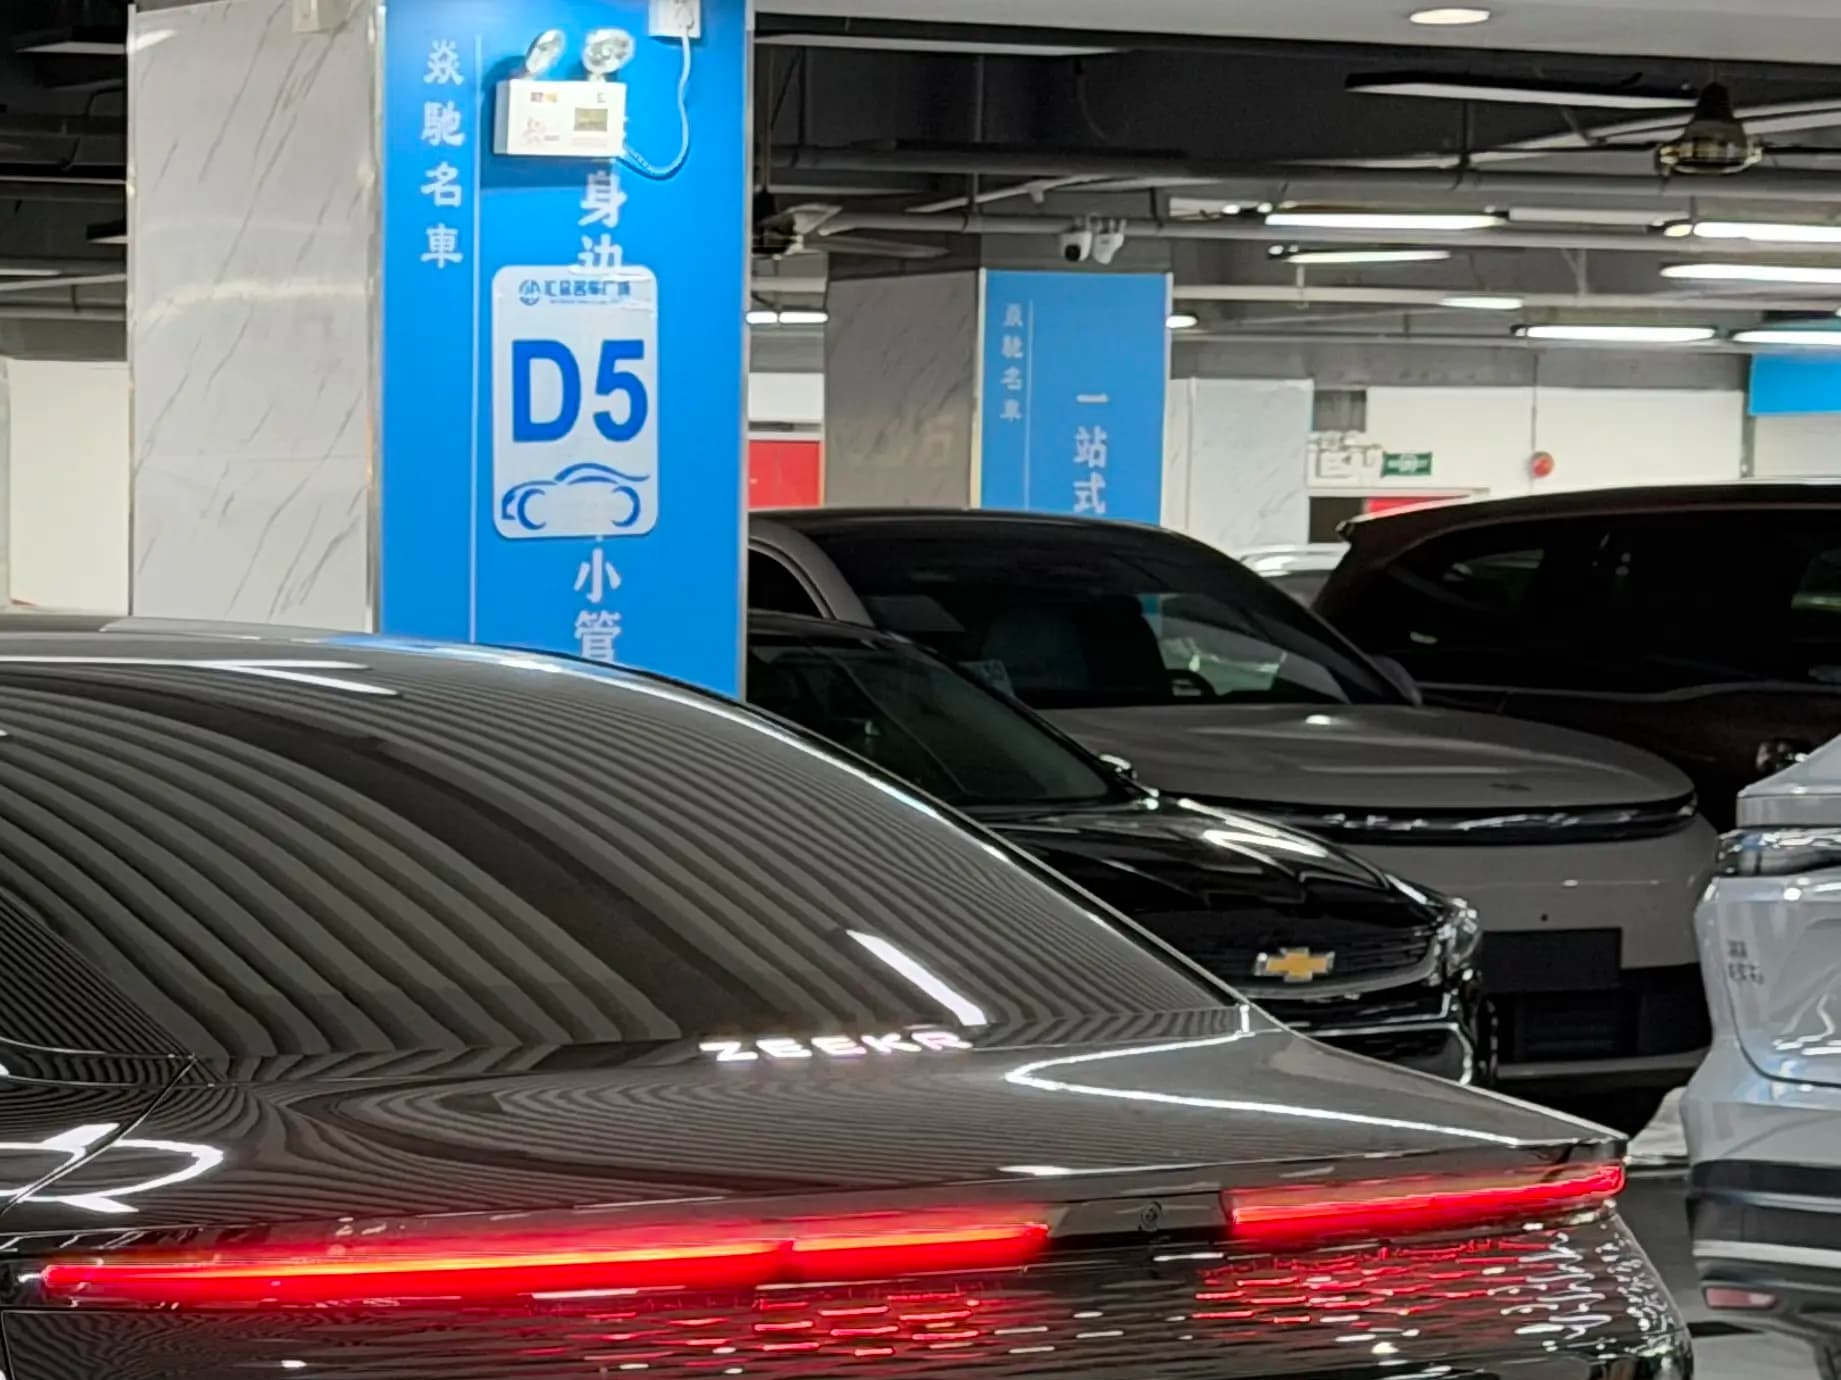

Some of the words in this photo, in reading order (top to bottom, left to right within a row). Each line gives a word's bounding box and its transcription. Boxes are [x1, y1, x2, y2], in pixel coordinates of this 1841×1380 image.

[511, 339, 649, 443] D5
[1073, 393, 1109, 515] 一站式
